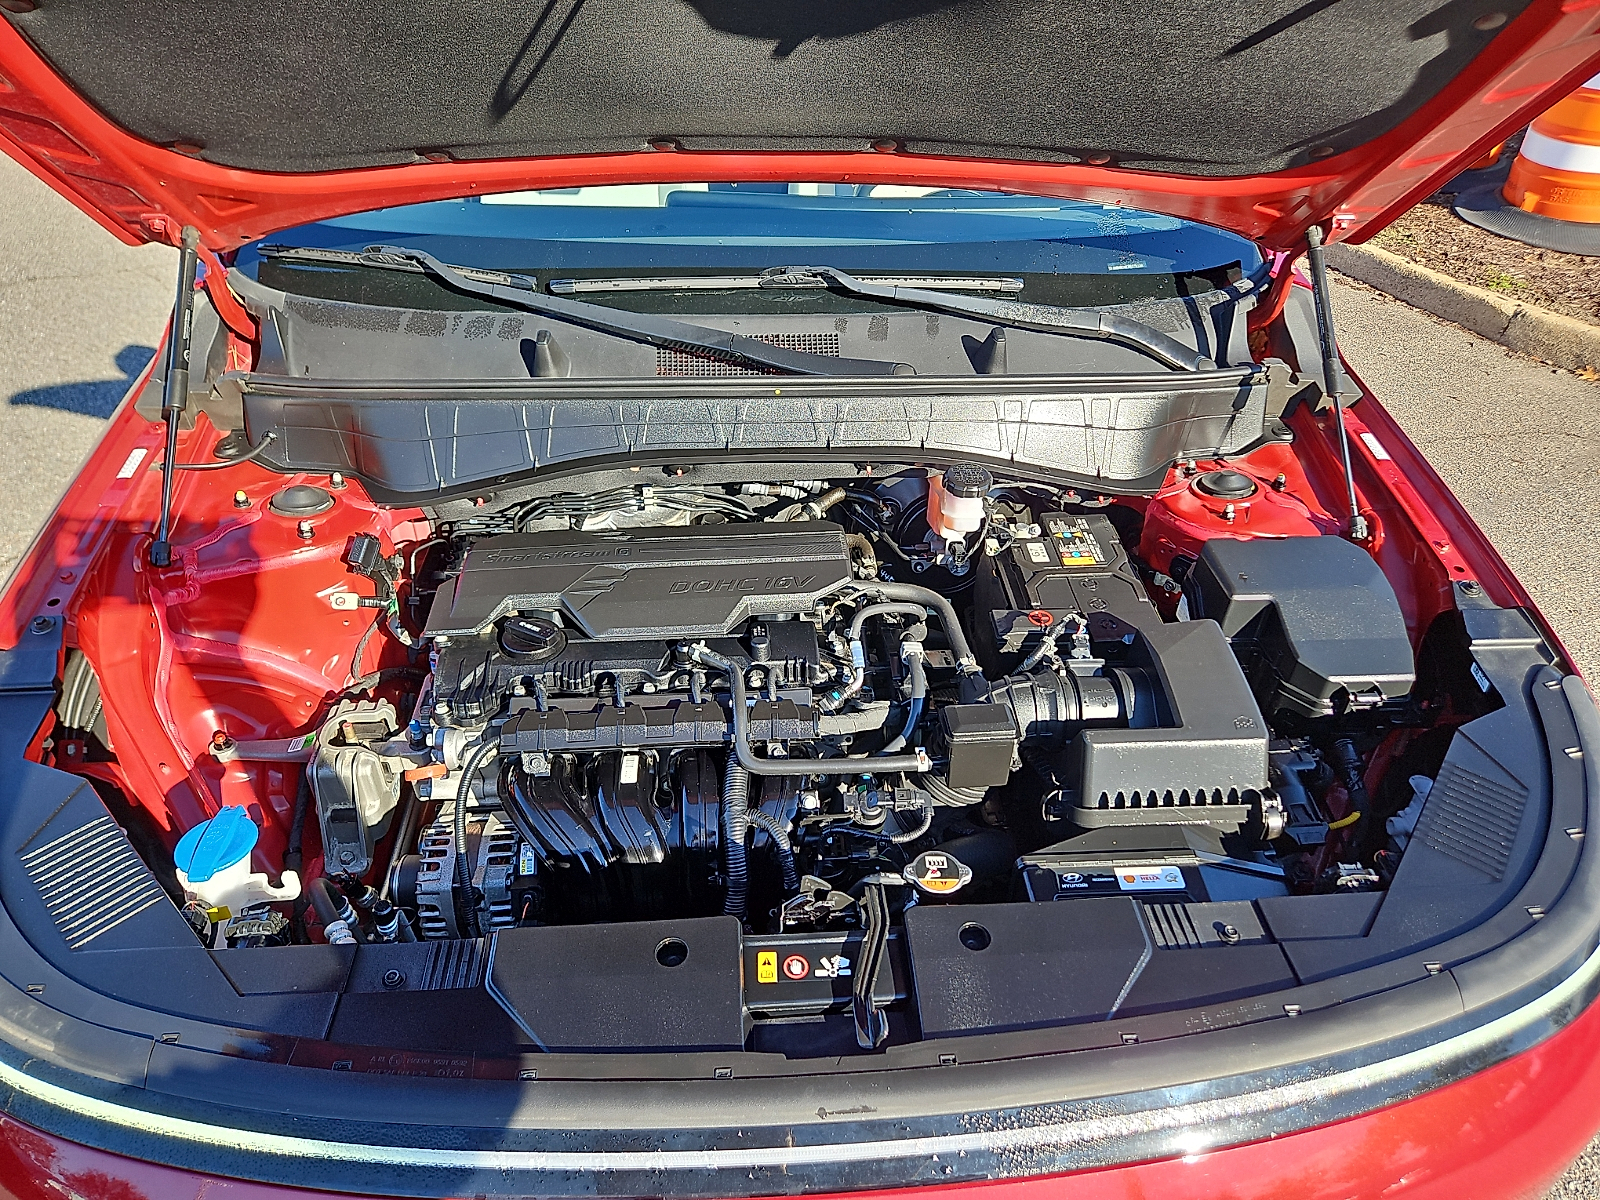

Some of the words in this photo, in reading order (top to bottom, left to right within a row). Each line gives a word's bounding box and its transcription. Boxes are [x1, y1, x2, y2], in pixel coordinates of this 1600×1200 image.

[482, 549, 611, 564] Smartstream
[668, 577, 759, 595] DOHC
[764, 574, 817, 590] 16V
